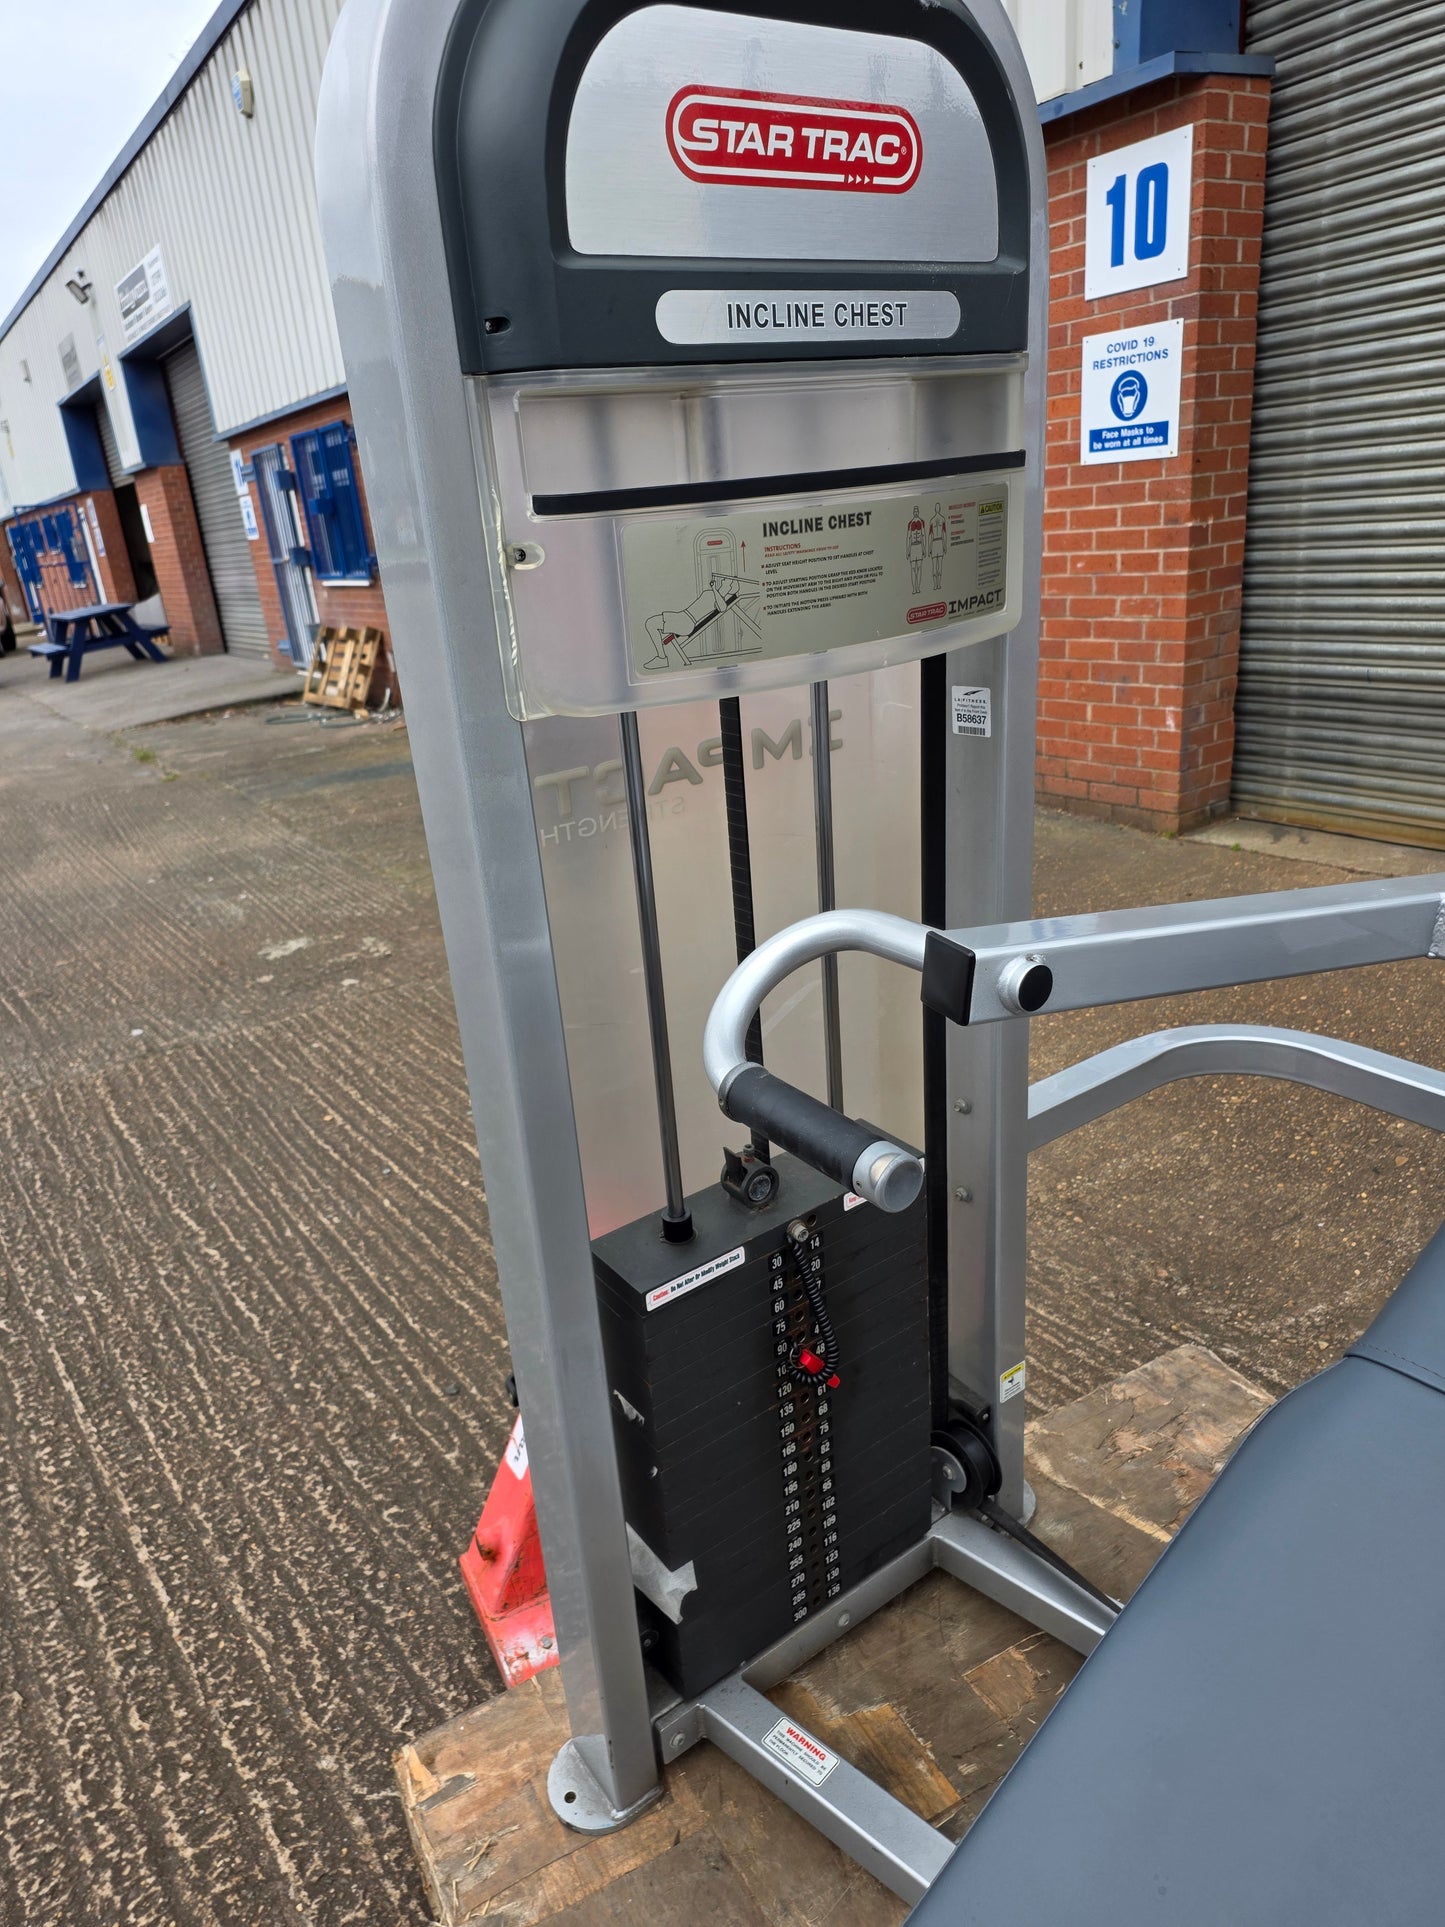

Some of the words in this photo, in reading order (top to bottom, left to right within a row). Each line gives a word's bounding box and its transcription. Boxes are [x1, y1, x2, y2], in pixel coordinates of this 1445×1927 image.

[690, 118, 794, 157] STAR
[801, 127, 900, 165] TRAC
[1106, 162, 1169, 268] 10
[727, 303, 824, 328] INCLINE
[834, 302, 907, 327] CHEST
[1107, 339, 1138, 354] COVID
[1143, 336, 1155, 347] 19
[1093, 348, 1169, 370] RESTRICTIONS
[1102, 430, 1119, 439] Face
[1121, 427, 1143, 437] Masks
[1146, 426, 1154, 434] to
[1093, 441, 1102, 450] be
[1104, 440, 1121, 448] worn
[1123, 438, 1130, 447] at
[1132, 437, 1141, 446] all
[1143, 435, 1164, 444] times
[763, 517, 823, 538] INCLINE
[828, 511, 872, 530] CHEST
[764, 543, 801, 552] INSTRUCTIONS
[949, 588, 1003, 614] IMPACT
[956, 713, 987, 725] B58637
[810, 1236, 820, 1250] 14
[772, 1256, 782, 1270] 30
[811, 1258, 820, 1271] 20
[773, 1277, 783, 1291] 45
[774, 1300, 785, 1313] 60
[775, 1321, 786, 1334] 75
[777, 1342, 787, 1355] 90
[816, 1342, 826, 1355] 48
[777, 1364, 788, 1377] 10
[778, 1382, 792, 1397] 120
[817, 1383, 826, 1396] 61
[780, 1403, 794, 1418] 135
[818, 1403, 828, 1416] 68
[780, 1423, 795, 1438] 150
[820, 1422, 829, 1435] 75
[782, 1442, 796, 1458] 165
[821, 1441, 830, 1454] 82
[783, 1462, 798, 1477] 180
[821, 1460, 831, 1473] 89
[784, 1480, 798, 1496] 195
[823, 1479, 832, 1492] 95
[785, 1500, 800, 1516] 210
[822, 1496, 836, 1511] 102
[787, 1518, 801, 1534] 225
[823, 1514, 836, 1529] 109
[788, 1537, 802, 1552] 240
[824, 1532, 837, 1547] 116
[825, 1550, 839, 1564] 123
[791, 1572, 805, 1588] 270
[827, 1567, 840, 1581] 130
[794, 1607, 808, 1622] 300
[786, 1727, 827, 1761] WARNING
